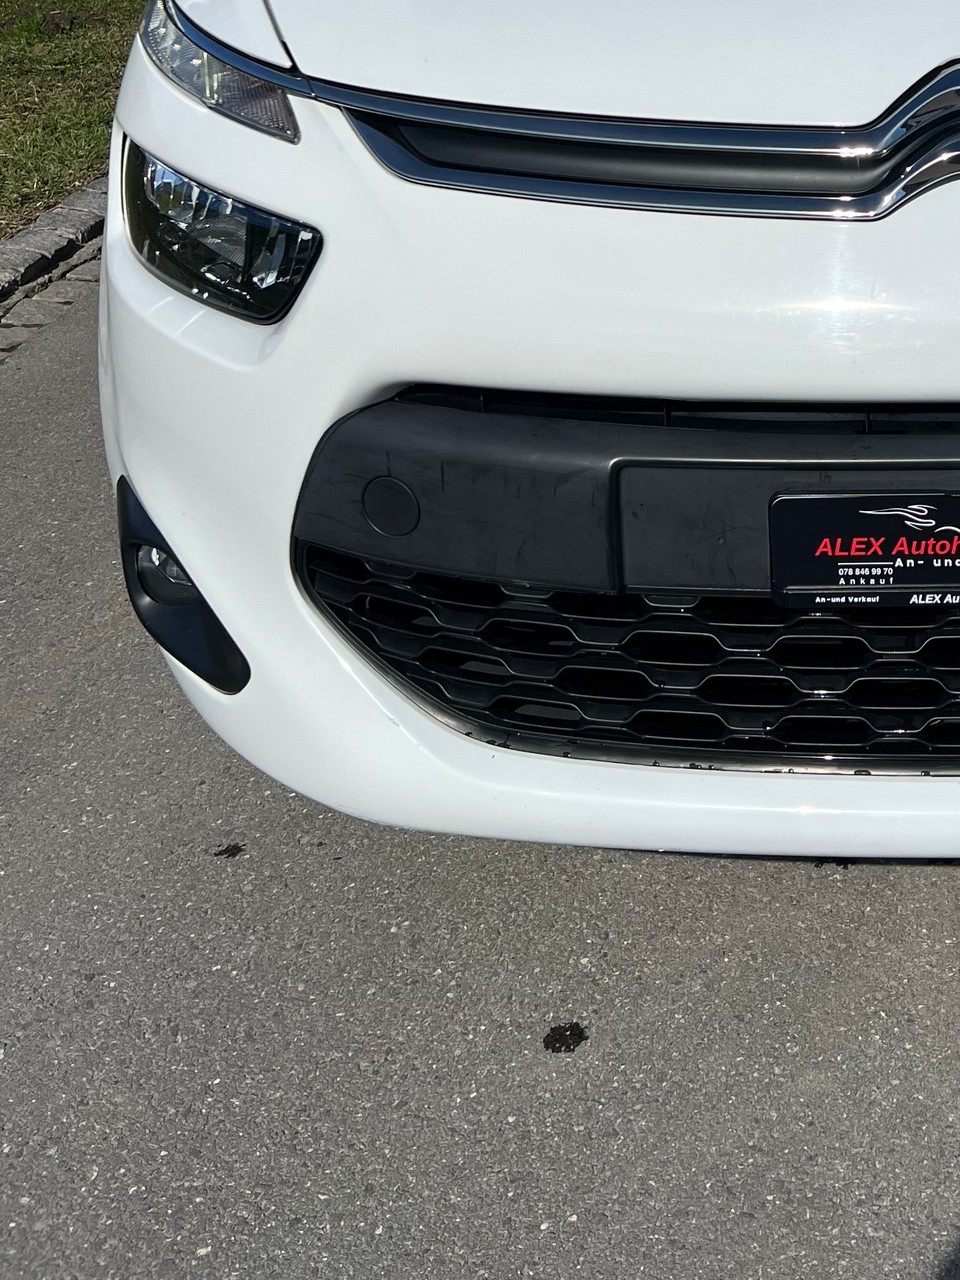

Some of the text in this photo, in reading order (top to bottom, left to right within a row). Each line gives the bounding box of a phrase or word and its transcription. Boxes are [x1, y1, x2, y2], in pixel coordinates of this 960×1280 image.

[814, 537, 886, 556] ALEX
[894, 557, 924, 567] An-
[883, 567, 893, 575] 70
[838, 577, 894, 585] Ankauf
[848, 595, 880, 603] Verkauf
[909, 594, 942, 604] ALEX
